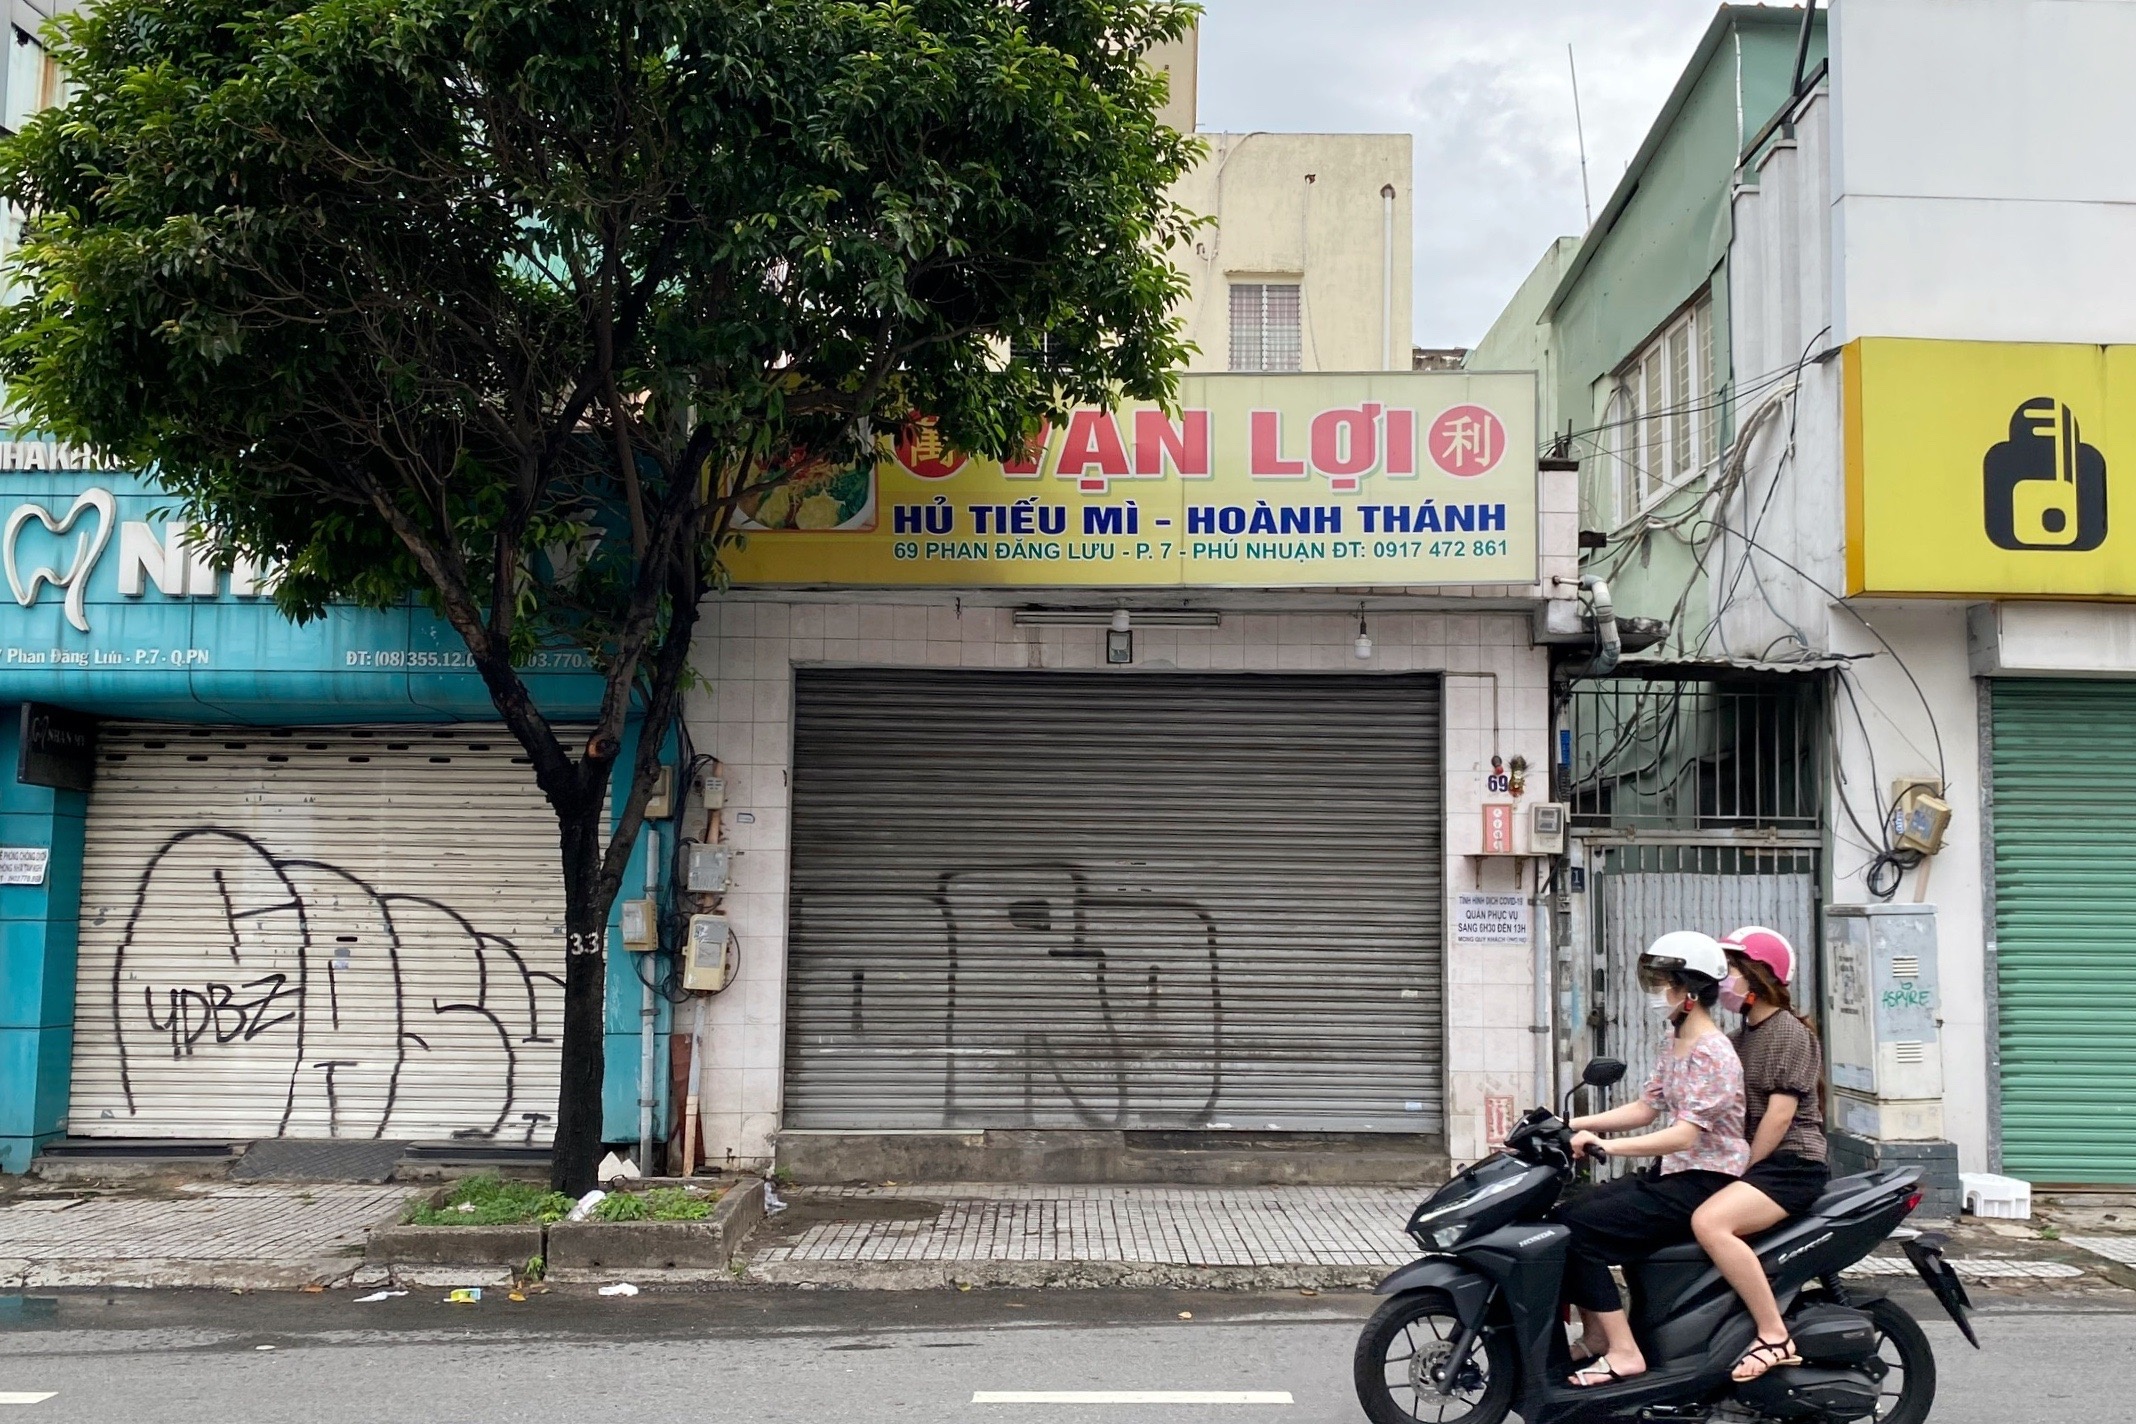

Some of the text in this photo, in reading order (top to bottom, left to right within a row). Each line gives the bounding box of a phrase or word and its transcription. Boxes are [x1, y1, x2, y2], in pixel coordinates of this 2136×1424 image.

[1250, 402, 1415, 490] LỢI
[1440, 413, 1493, 468] 利
[893, 496, 954, 535] HỦ
[968, 496, 1066, 535] TIẾU
[1082, 500, 1139, 535] MÌ
[1187, 500, 1342, 535] HOÀNH
[1356, 498, 1507, 533] THÁNH
[893, 541, 919, 560] 69
[925, 541, 989, 560] PHAN
[994, 537, 1061, 560] ĐĂNG
[1067, 541, 1115, 560] LƯU
[1192, 538, 1238, 560] PHÚ
[1245, 539, 1326, 563] NHUẬN
[1331, 541, 1366, 559] ĐT:
[1372, 540, 1422, 558] 0917
[1428, 540, 1466, 558] 472
[1472, 539, 1508, 557] 861
[7, 648, 46, 664] Phan
[170, 648, 210, 667] Q.PN
[1487, 774, 1509, 793] 69
[569, 931, 599, 956] 33
[1518, 1229, 1556, 1248] HONDA
